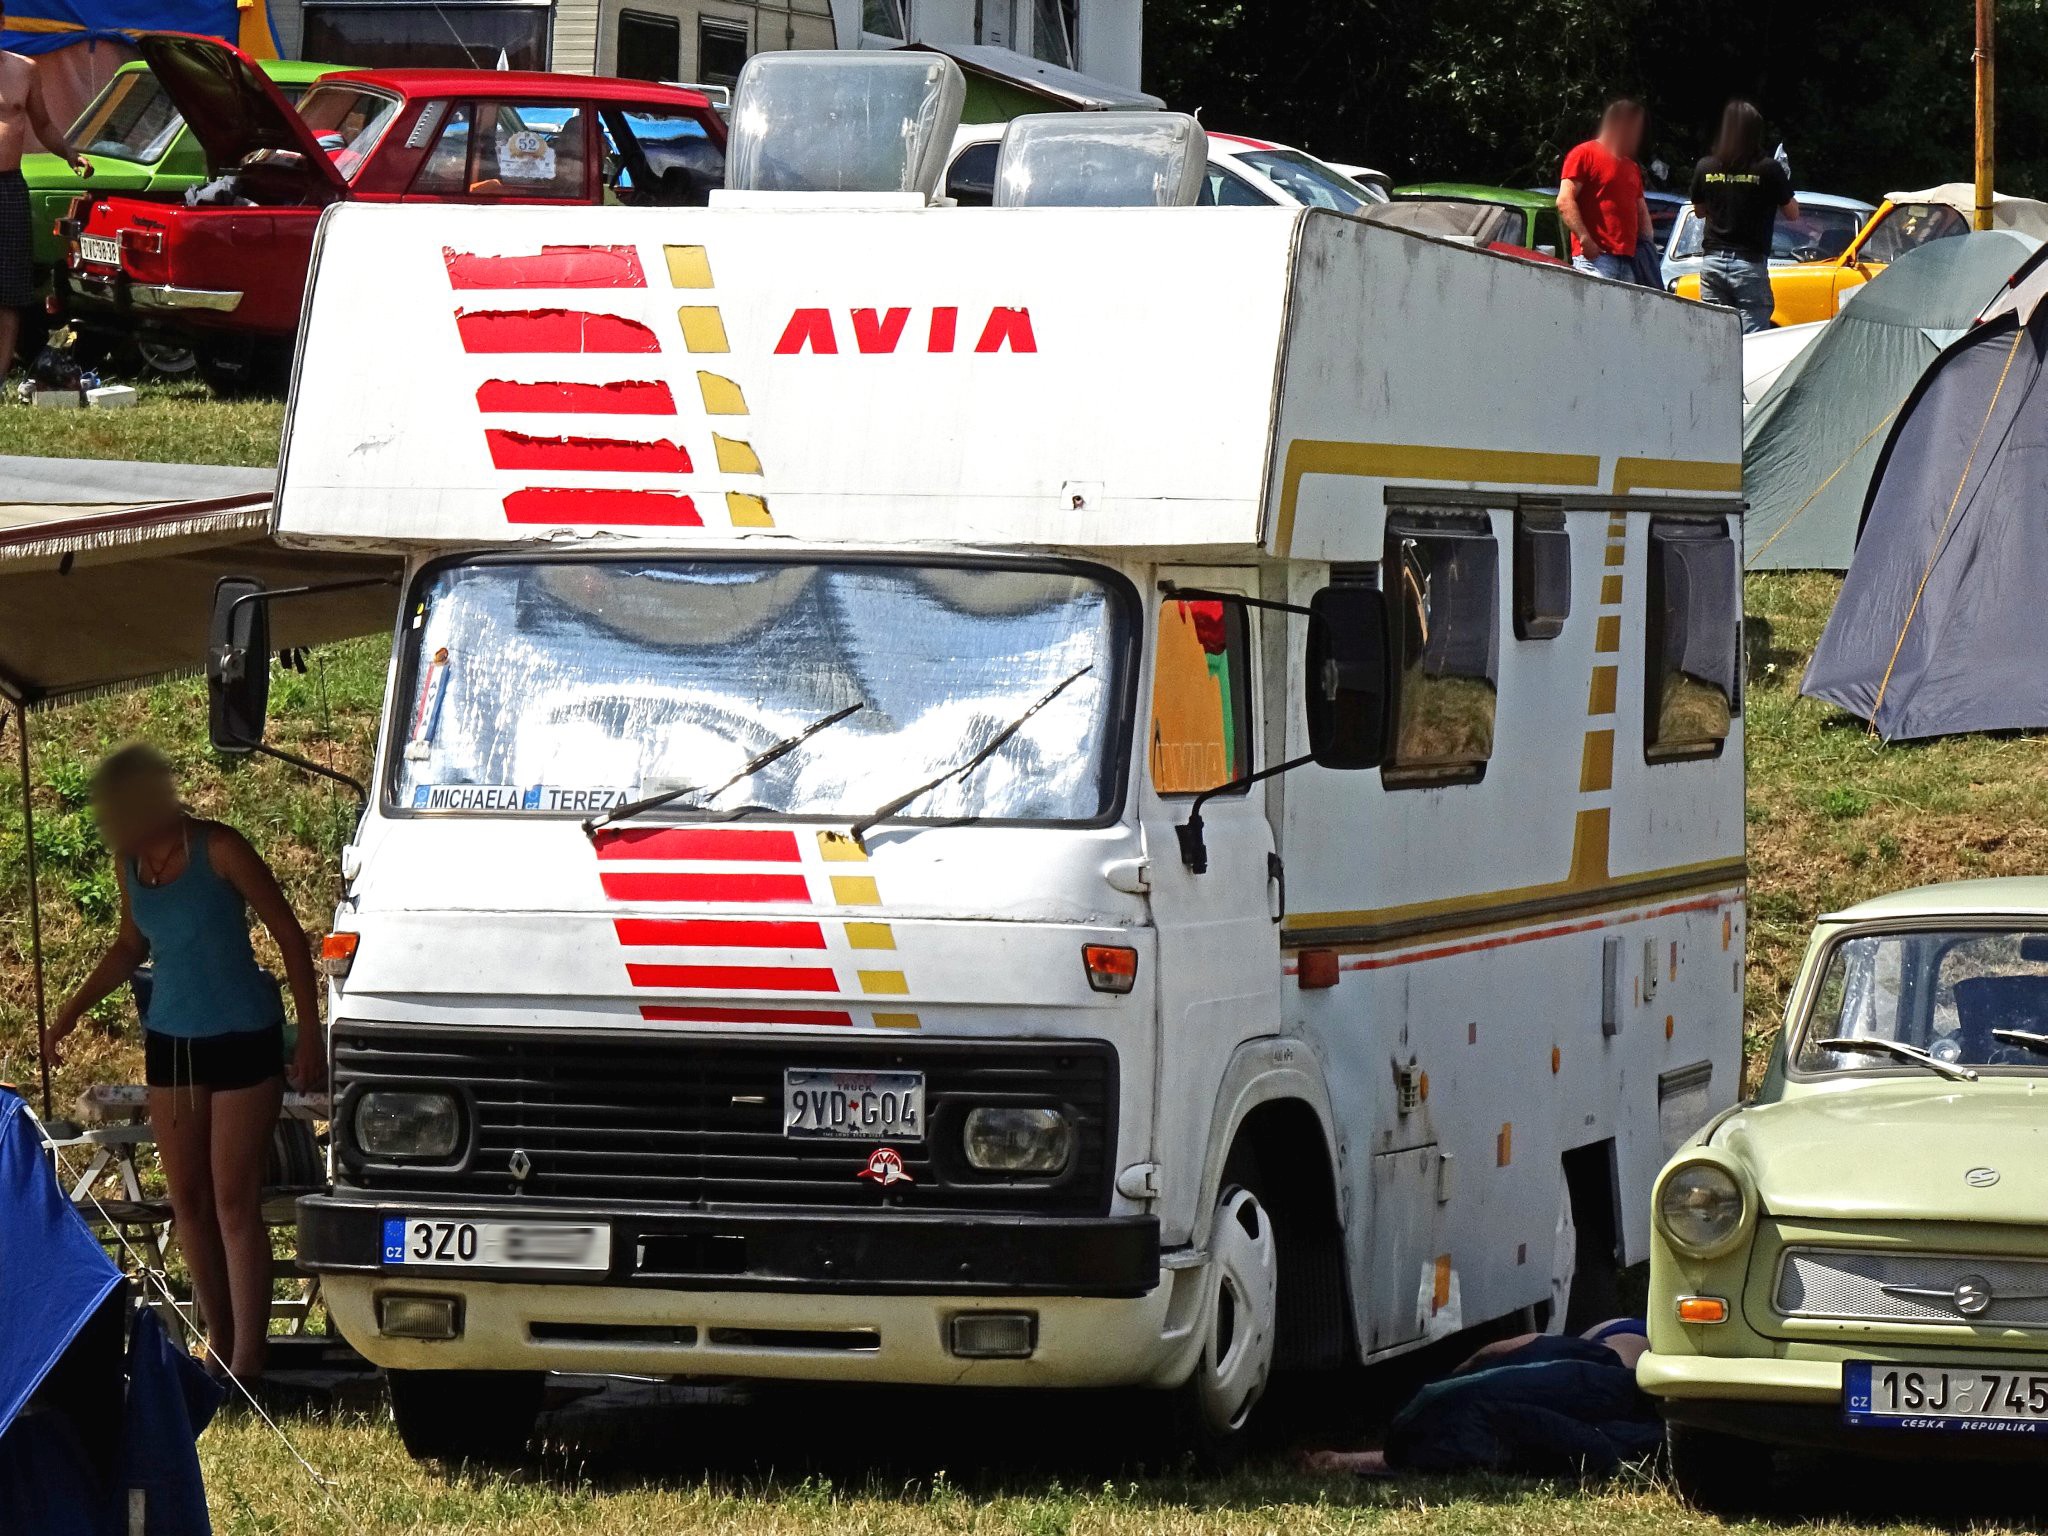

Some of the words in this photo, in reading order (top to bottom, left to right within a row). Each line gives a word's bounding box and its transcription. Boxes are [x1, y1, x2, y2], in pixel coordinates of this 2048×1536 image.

[518, 138, 537, 151] 52
[773, 306, 1038, 355] AVIA
[421, 680, 438, 727] AVIA
[430, 788, 519, 809] MICHAELA
[548, 789, 628, 812] TEREZA
[837, 1083, 873, 1092] TRUCK
[792, 1090, 847, 1126] 9VD
[385, 1246, 403, 1258] CZ
[1850, 1396, 1869, 1408] CZ
[1882, 1371, 1949, 1411] 1SJ
[1961, 1421, 2036, 1432] REPUBLIKA
